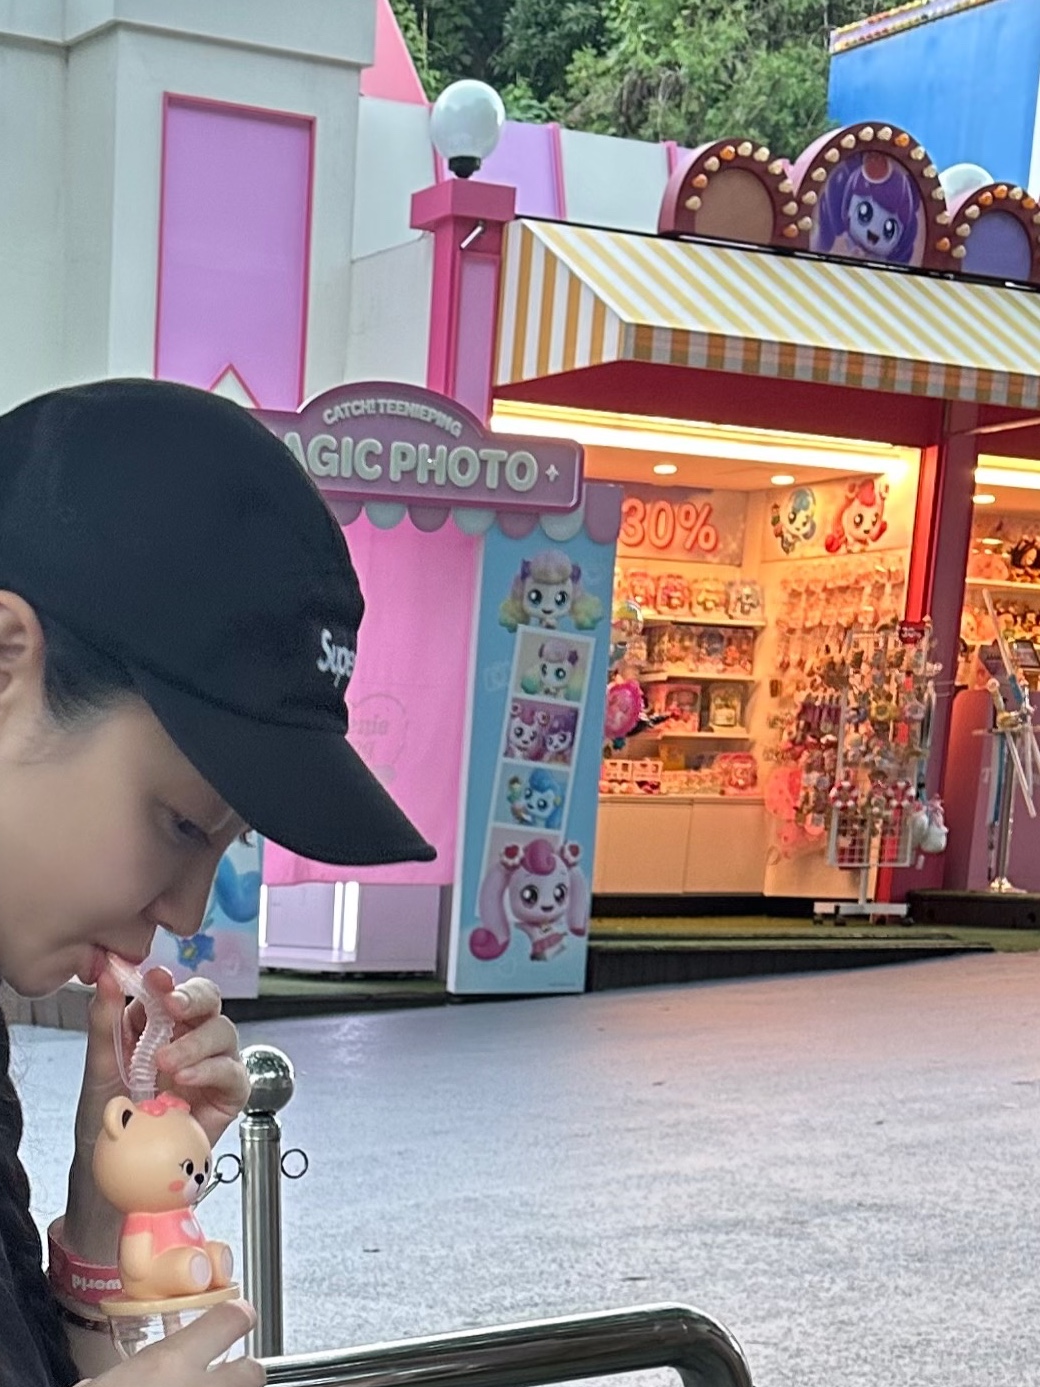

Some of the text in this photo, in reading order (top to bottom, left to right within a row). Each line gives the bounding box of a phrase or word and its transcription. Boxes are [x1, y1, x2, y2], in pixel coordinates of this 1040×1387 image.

[322, 398, 376, 425] CATCH!
[389, 441, 539, 493] PHOTO
[619, 496, 719, 553] 30%
